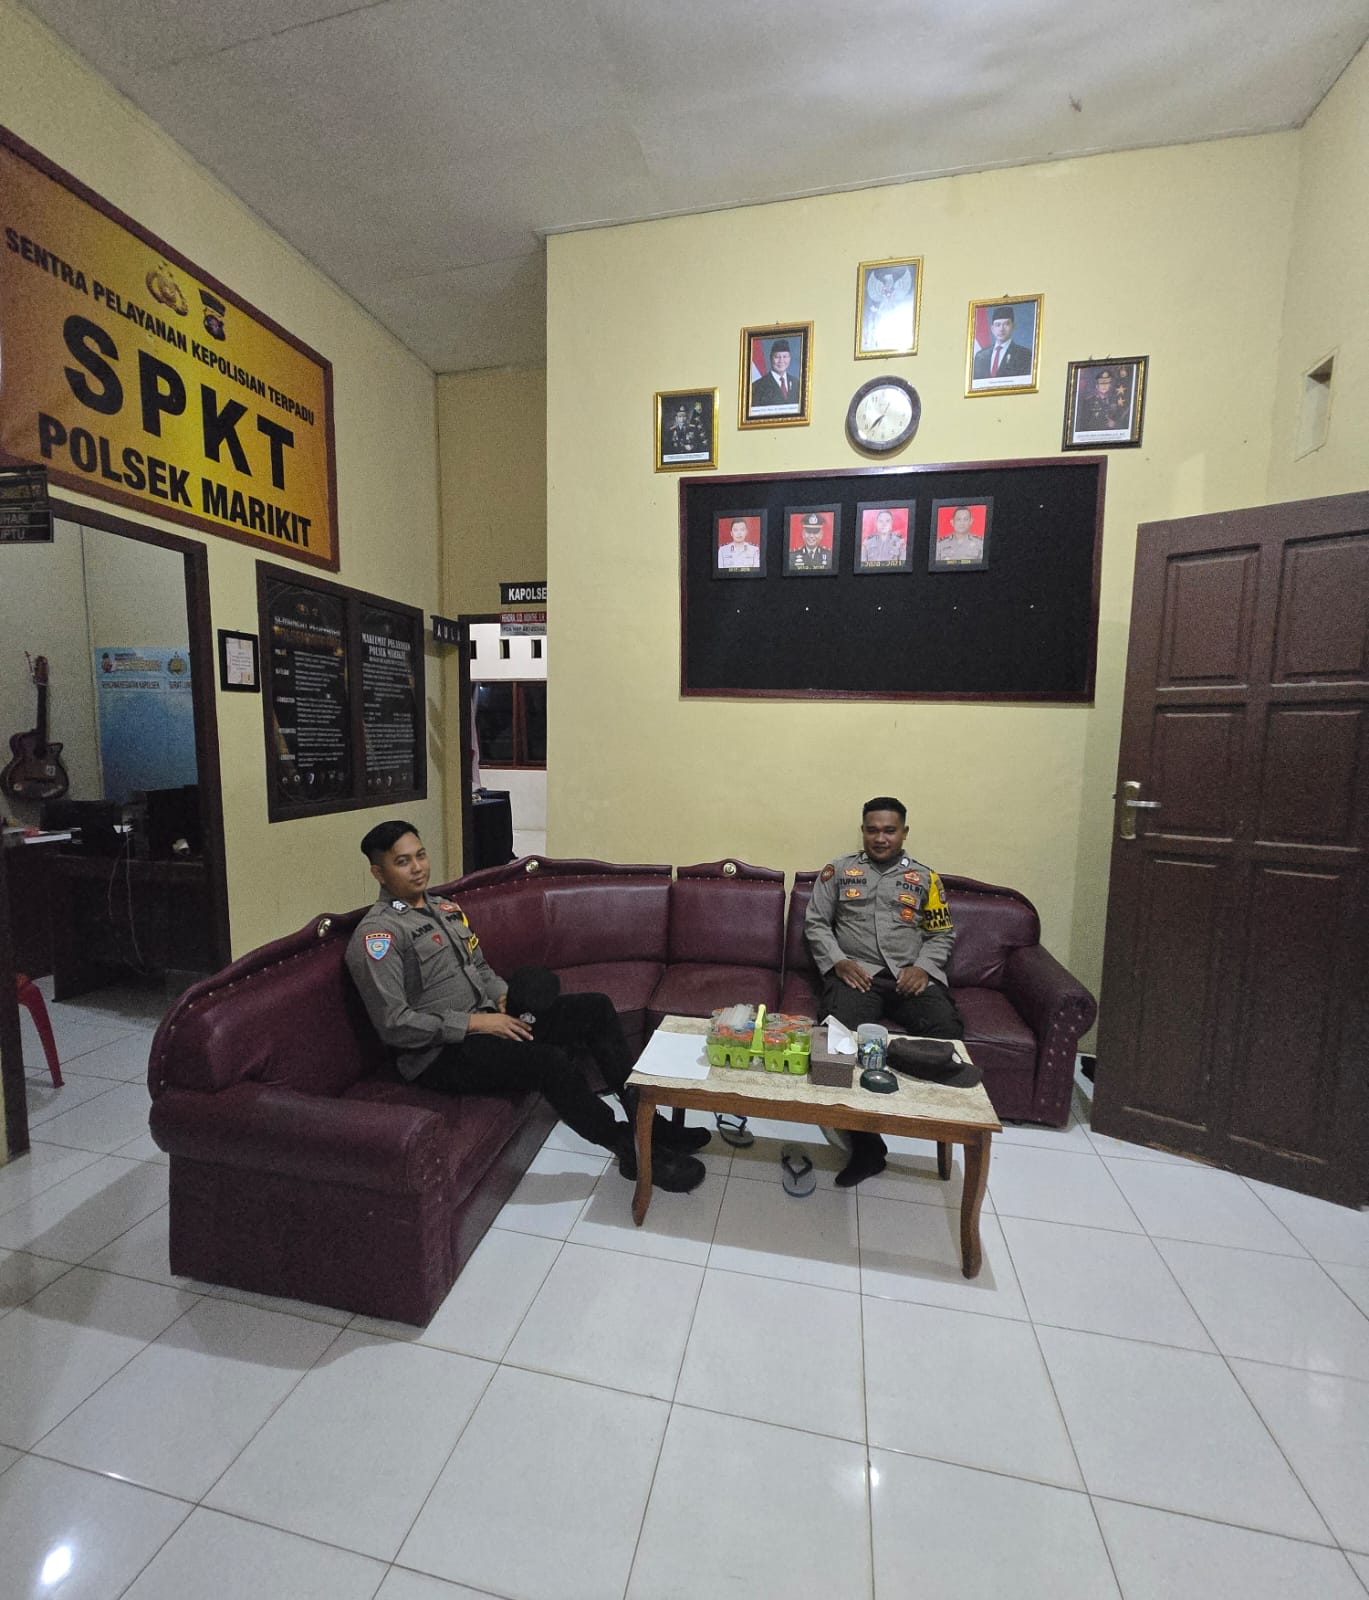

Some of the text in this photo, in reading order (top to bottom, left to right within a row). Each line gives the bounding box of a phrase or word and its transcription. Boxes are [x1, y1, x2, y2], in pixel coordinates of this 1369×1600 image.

[5, 227, 315, 426] SENTRA PELAYANAN KEPOLISIAN TERPADU
[63, 315, 295, 491] SPKT
[38, 411, 312, 548] POLSEK MARIKIT
